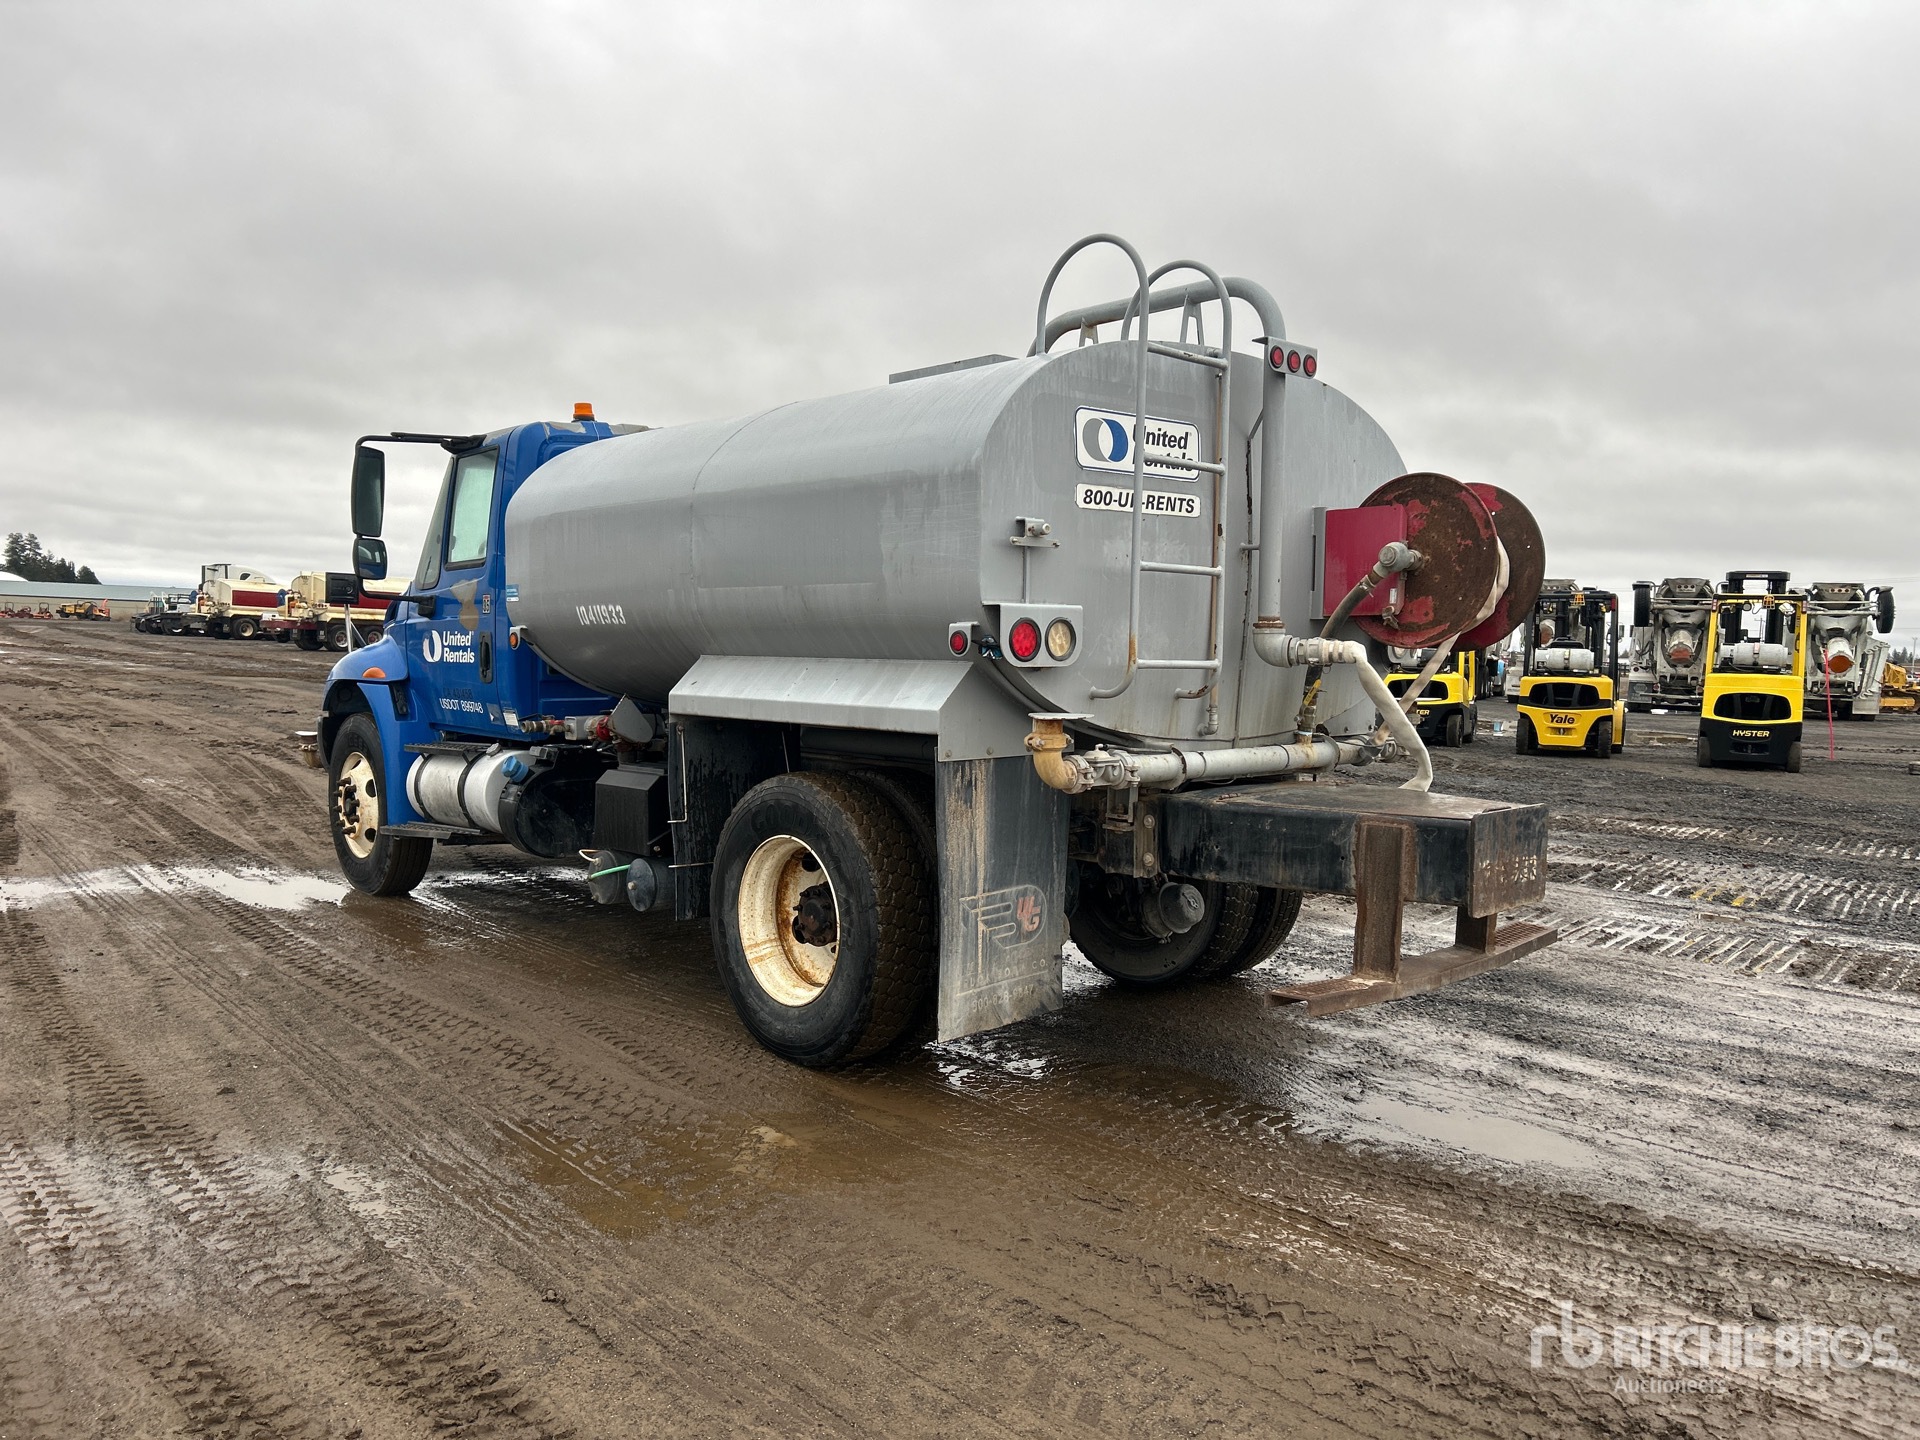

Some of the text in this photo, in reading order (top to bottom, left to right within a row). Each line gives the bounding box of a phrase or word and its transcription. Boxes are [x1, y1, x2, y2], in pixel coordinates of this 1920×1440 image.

[1133, 424, 1189, 450] nited
[443, 630, 472, 646] United
[443, 647, 475, 663] Rentals
[439, 698, 460, 710] USDOT
[1549, 713, 1575, 724] Yale
[1732, 729, 1770, 737] HYSTER
